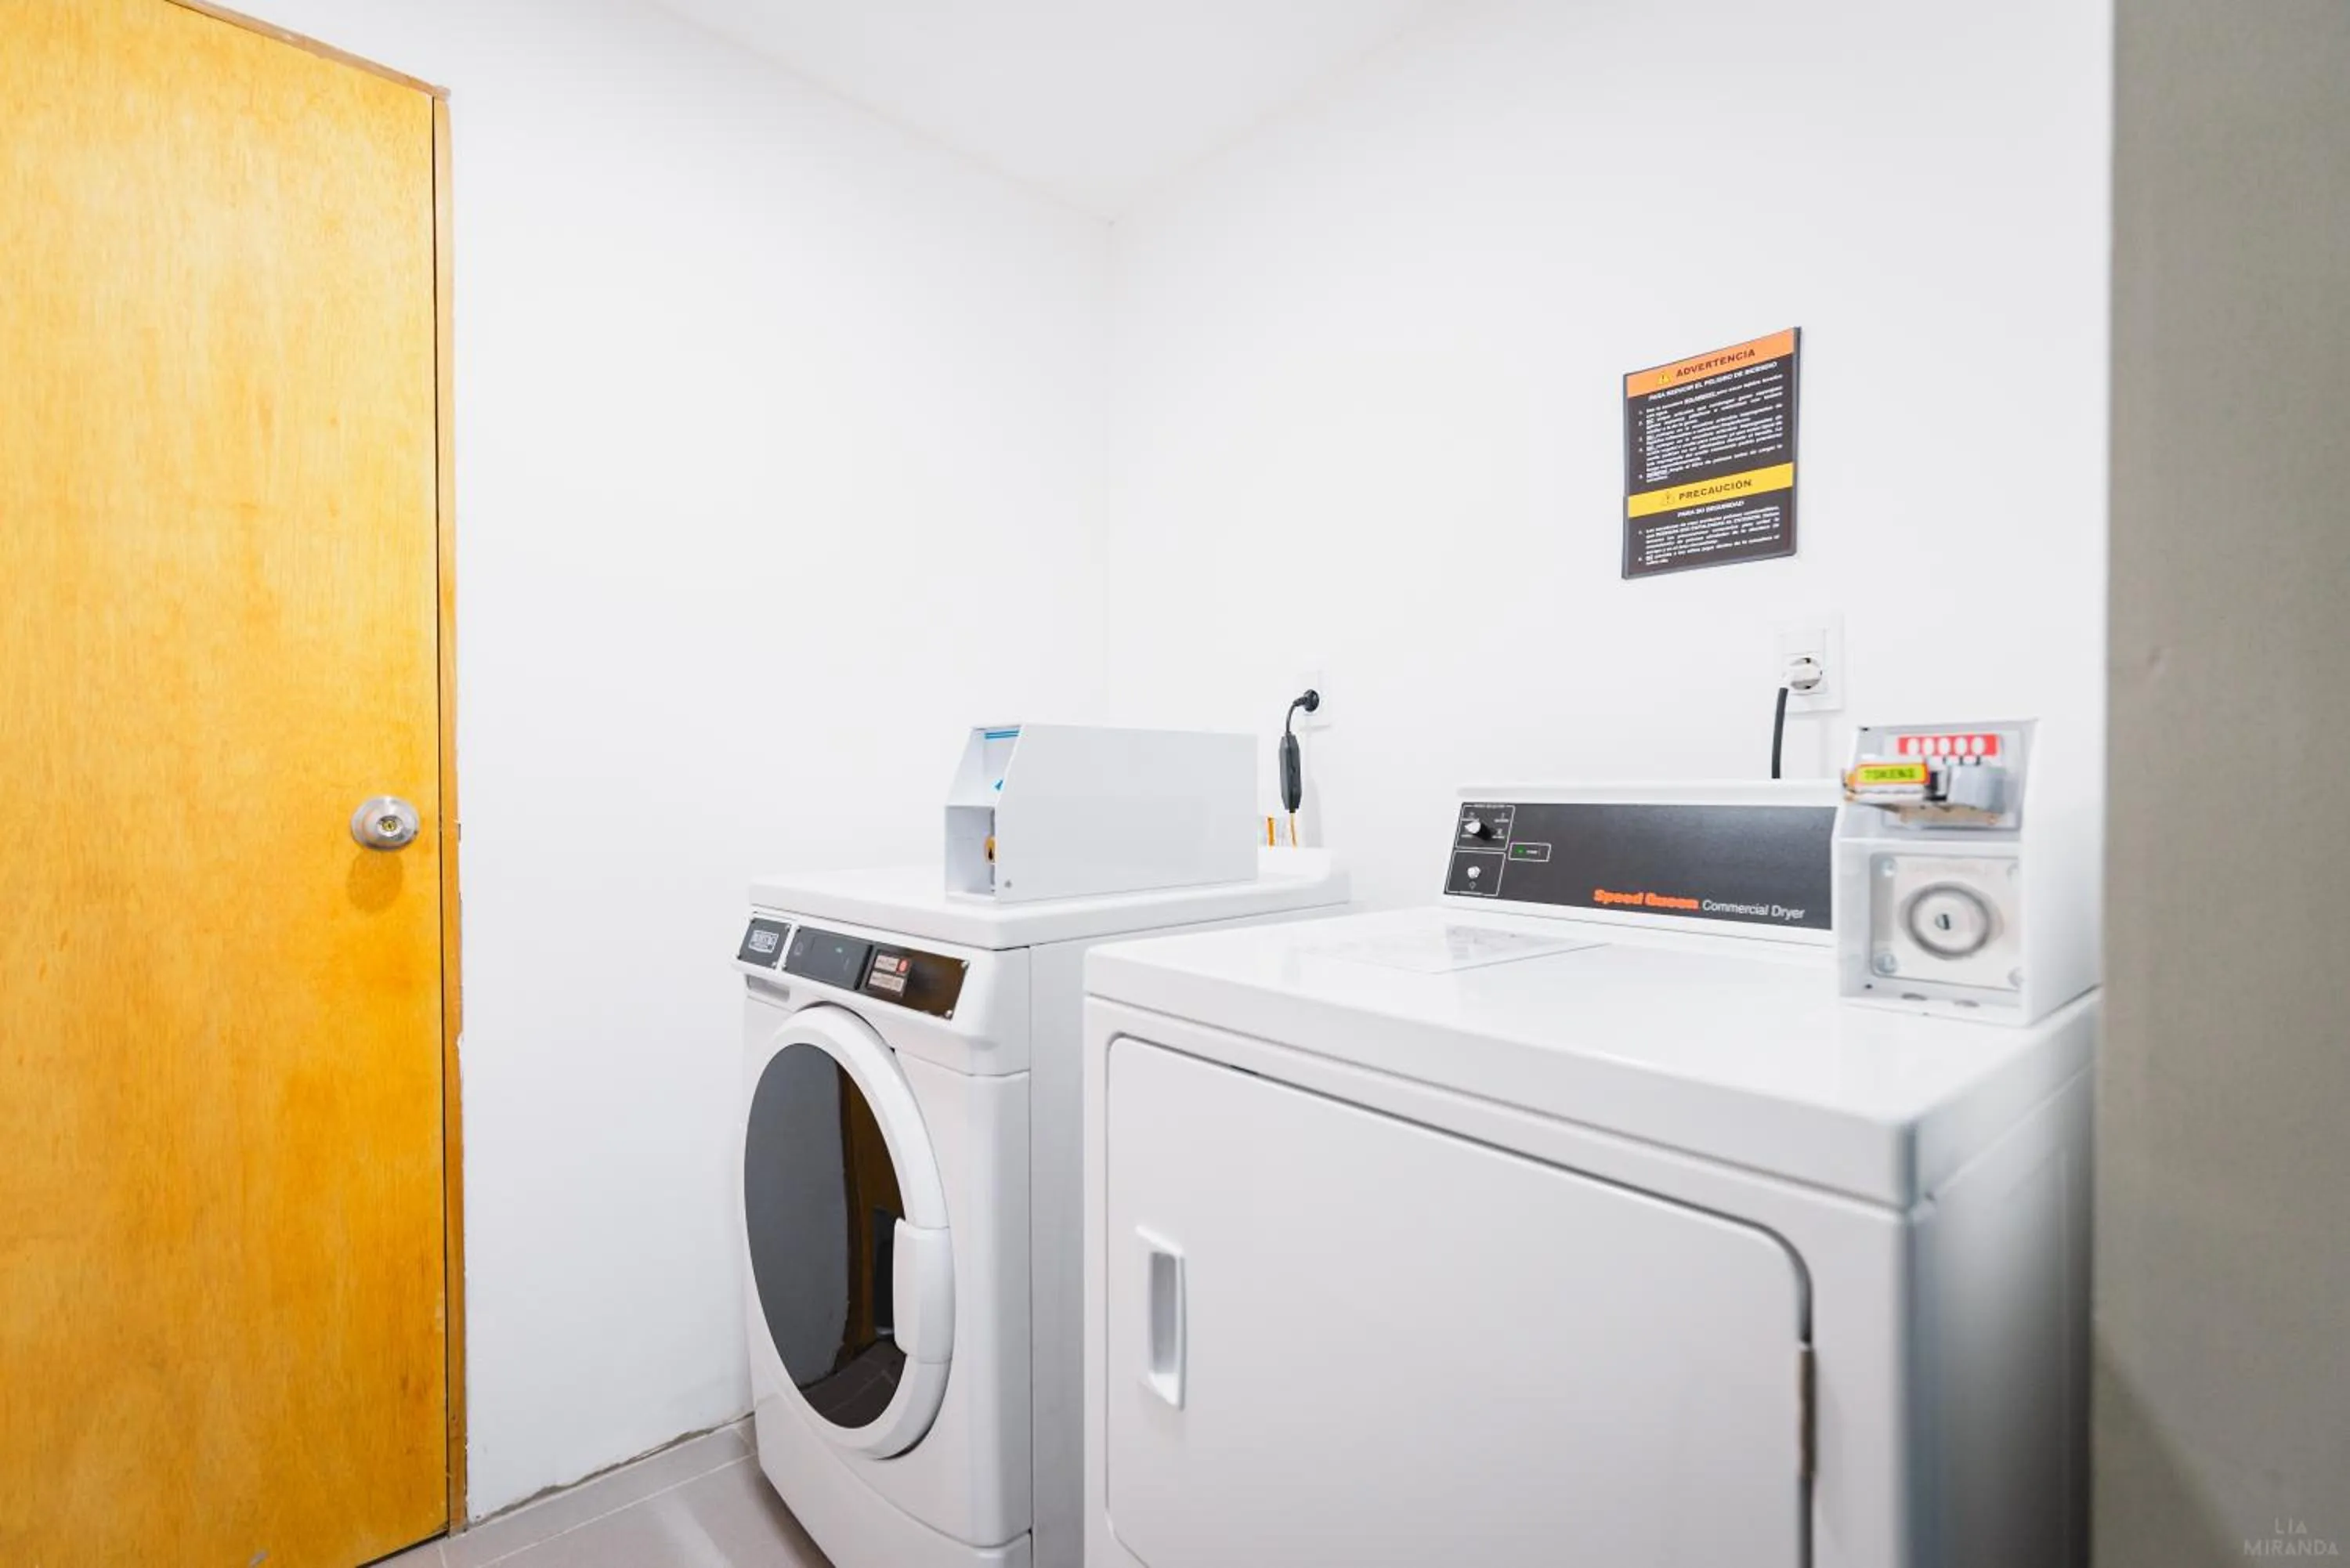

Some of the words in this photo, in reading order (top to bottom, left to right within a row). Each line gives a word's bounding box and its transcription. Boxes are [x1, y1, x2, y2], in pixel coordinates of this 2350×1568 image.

[1676, 349, 1755, 377] ADVERTENCIA
[1679, 479, 1752, 500] PRECAUCIÓN
[1593, 889, 1644, 905] Speed
[1702, 899, 1769, 916] Commercial
[1771, 905, 1806, 921] Dryer
